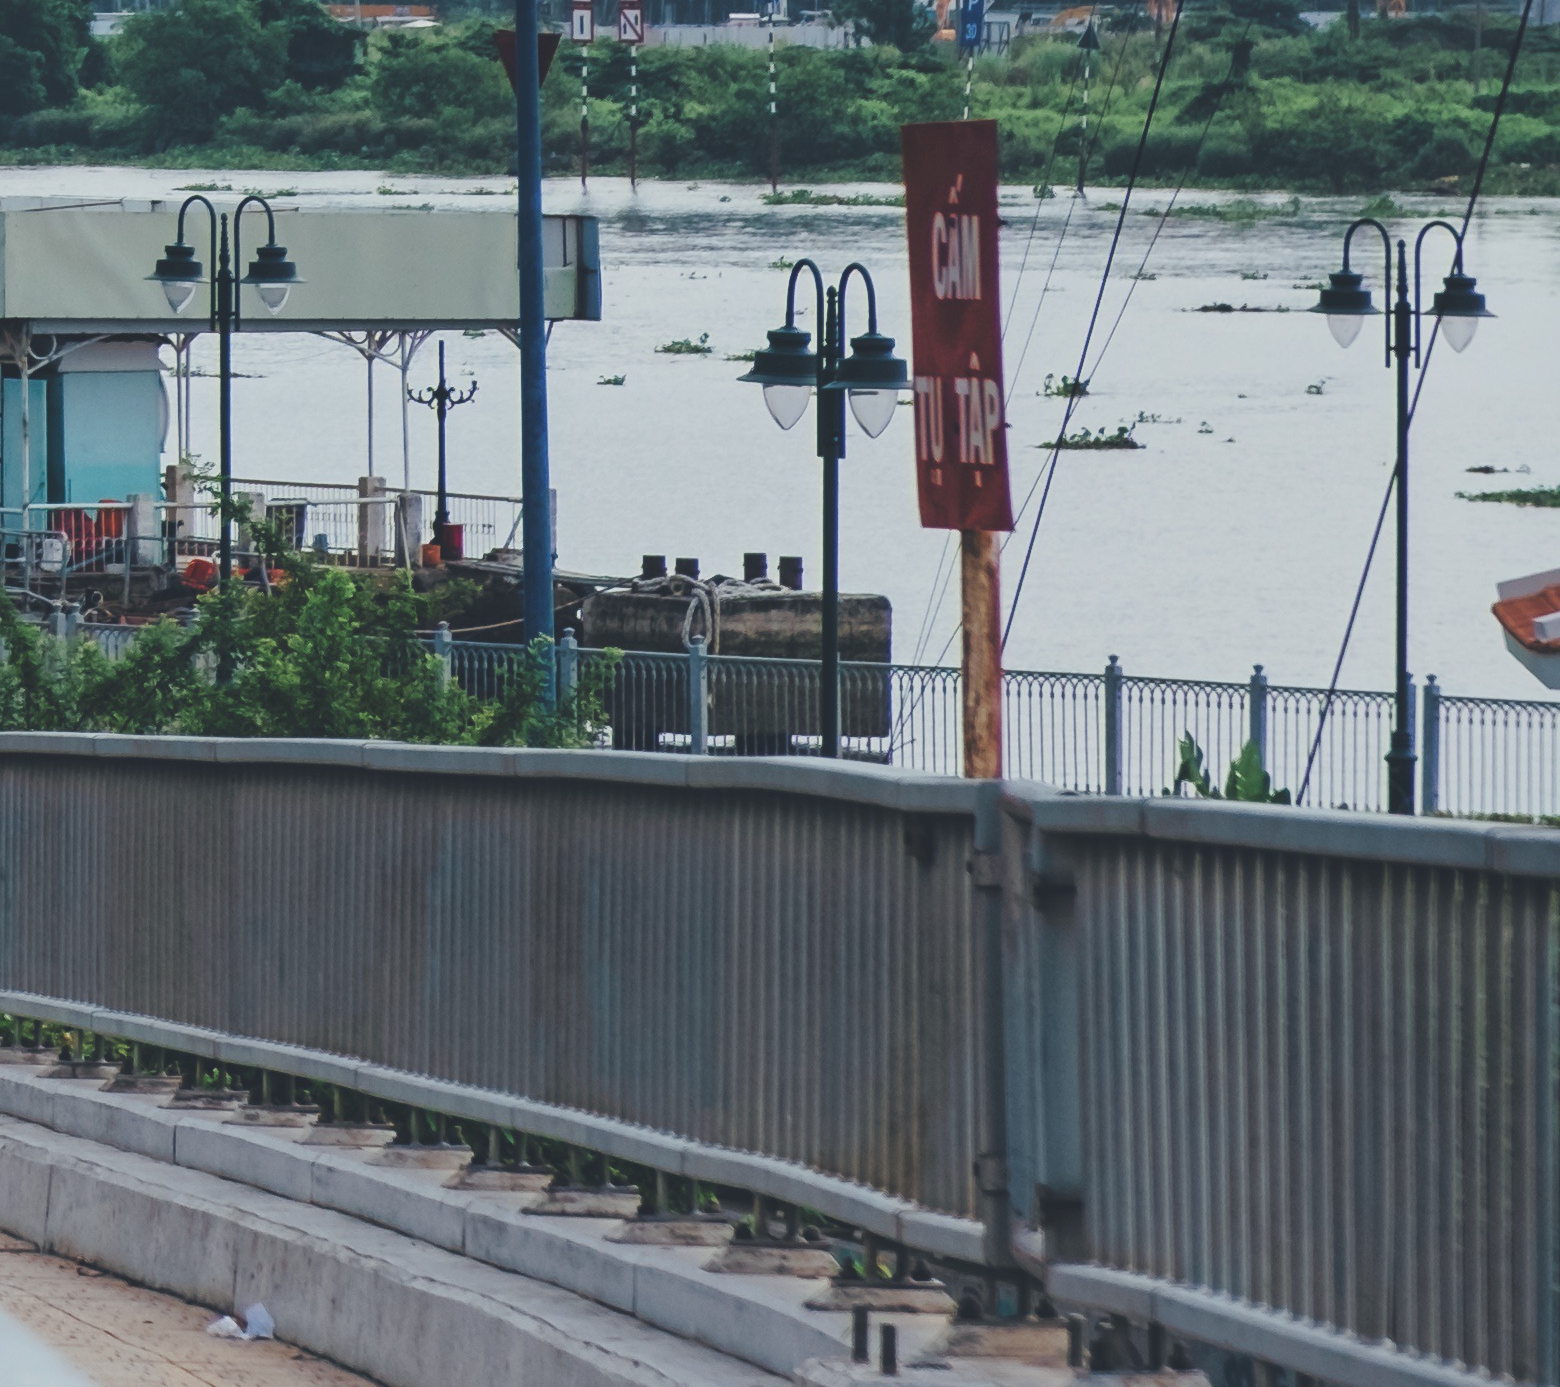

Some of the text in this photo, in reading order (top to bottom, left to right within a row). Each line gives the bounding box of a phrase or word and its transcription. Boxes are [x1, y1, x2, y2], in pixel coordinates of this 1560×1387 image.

[931, 174, 983, 301] CẤM
[914, 351, 1001, 488] TỤ TẬP
